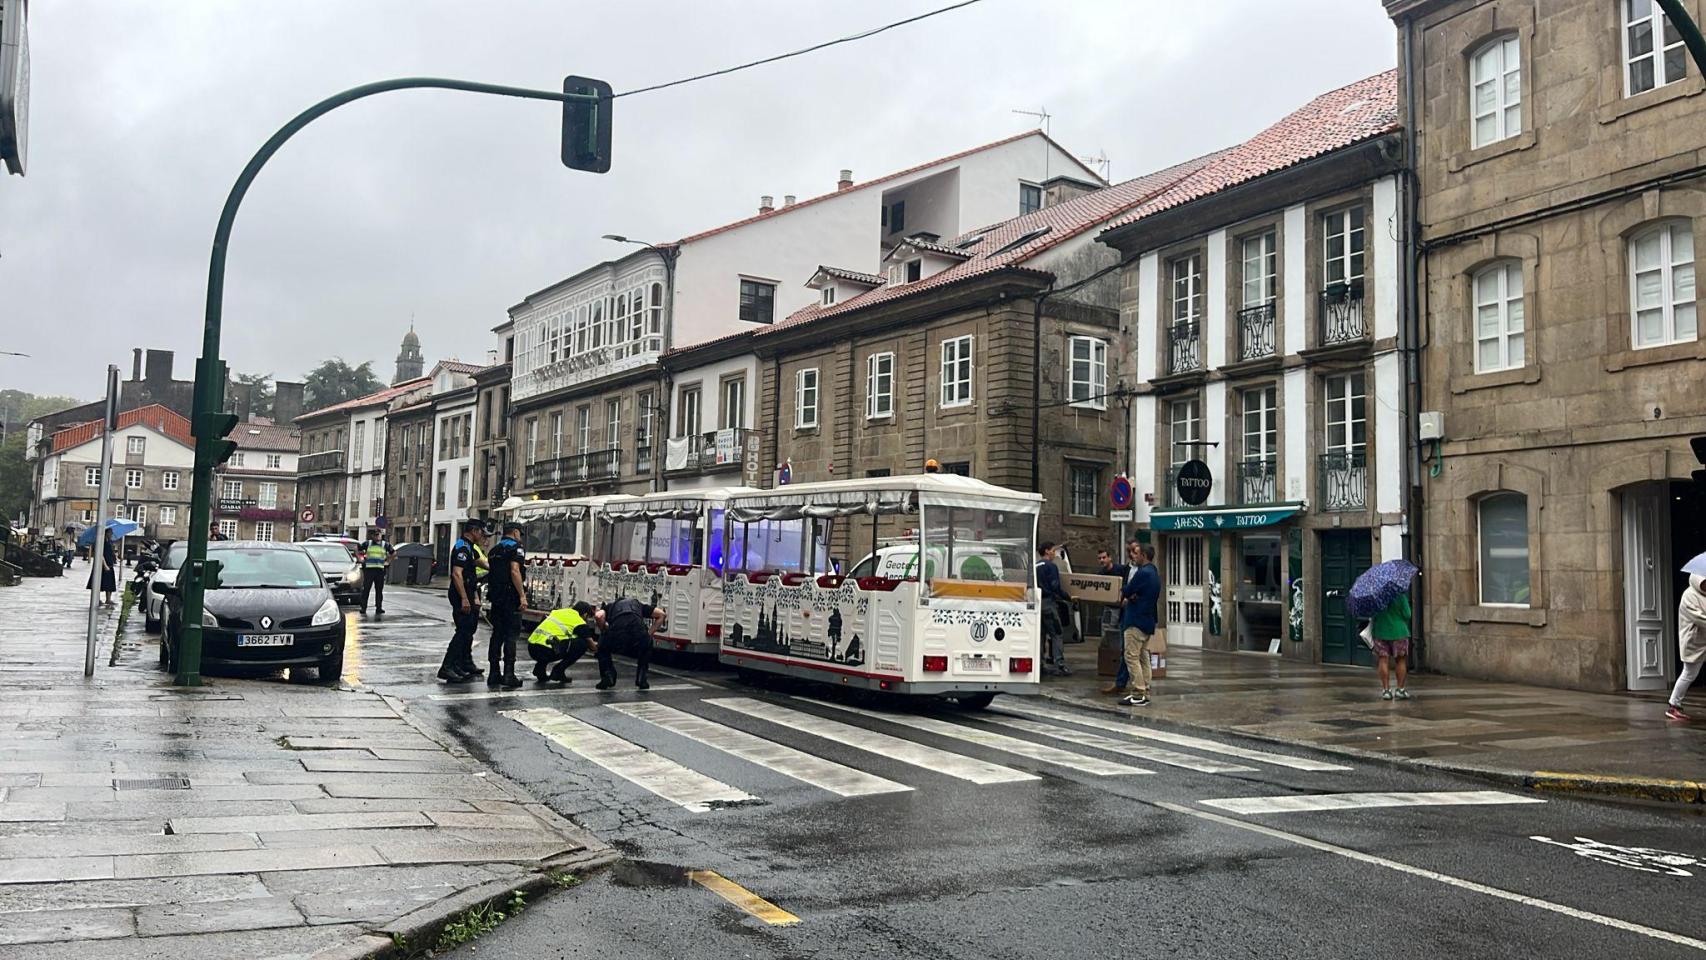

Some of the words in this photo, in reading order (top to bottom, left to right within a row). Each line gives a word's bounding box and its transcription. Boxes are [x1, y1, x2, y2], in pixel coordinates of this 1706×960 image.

[1653, 407, 1662, 419] 9
[1180, 477, 1210, 488] TATTOO
[1174, 516, 1204, 529] ARESS
[1236, 514, 1267, 526] TATTOO
[974, 622, 985, 639] 20
[245, 635, 270, 645] 3662
[273, 635, 292, 645] FVW
